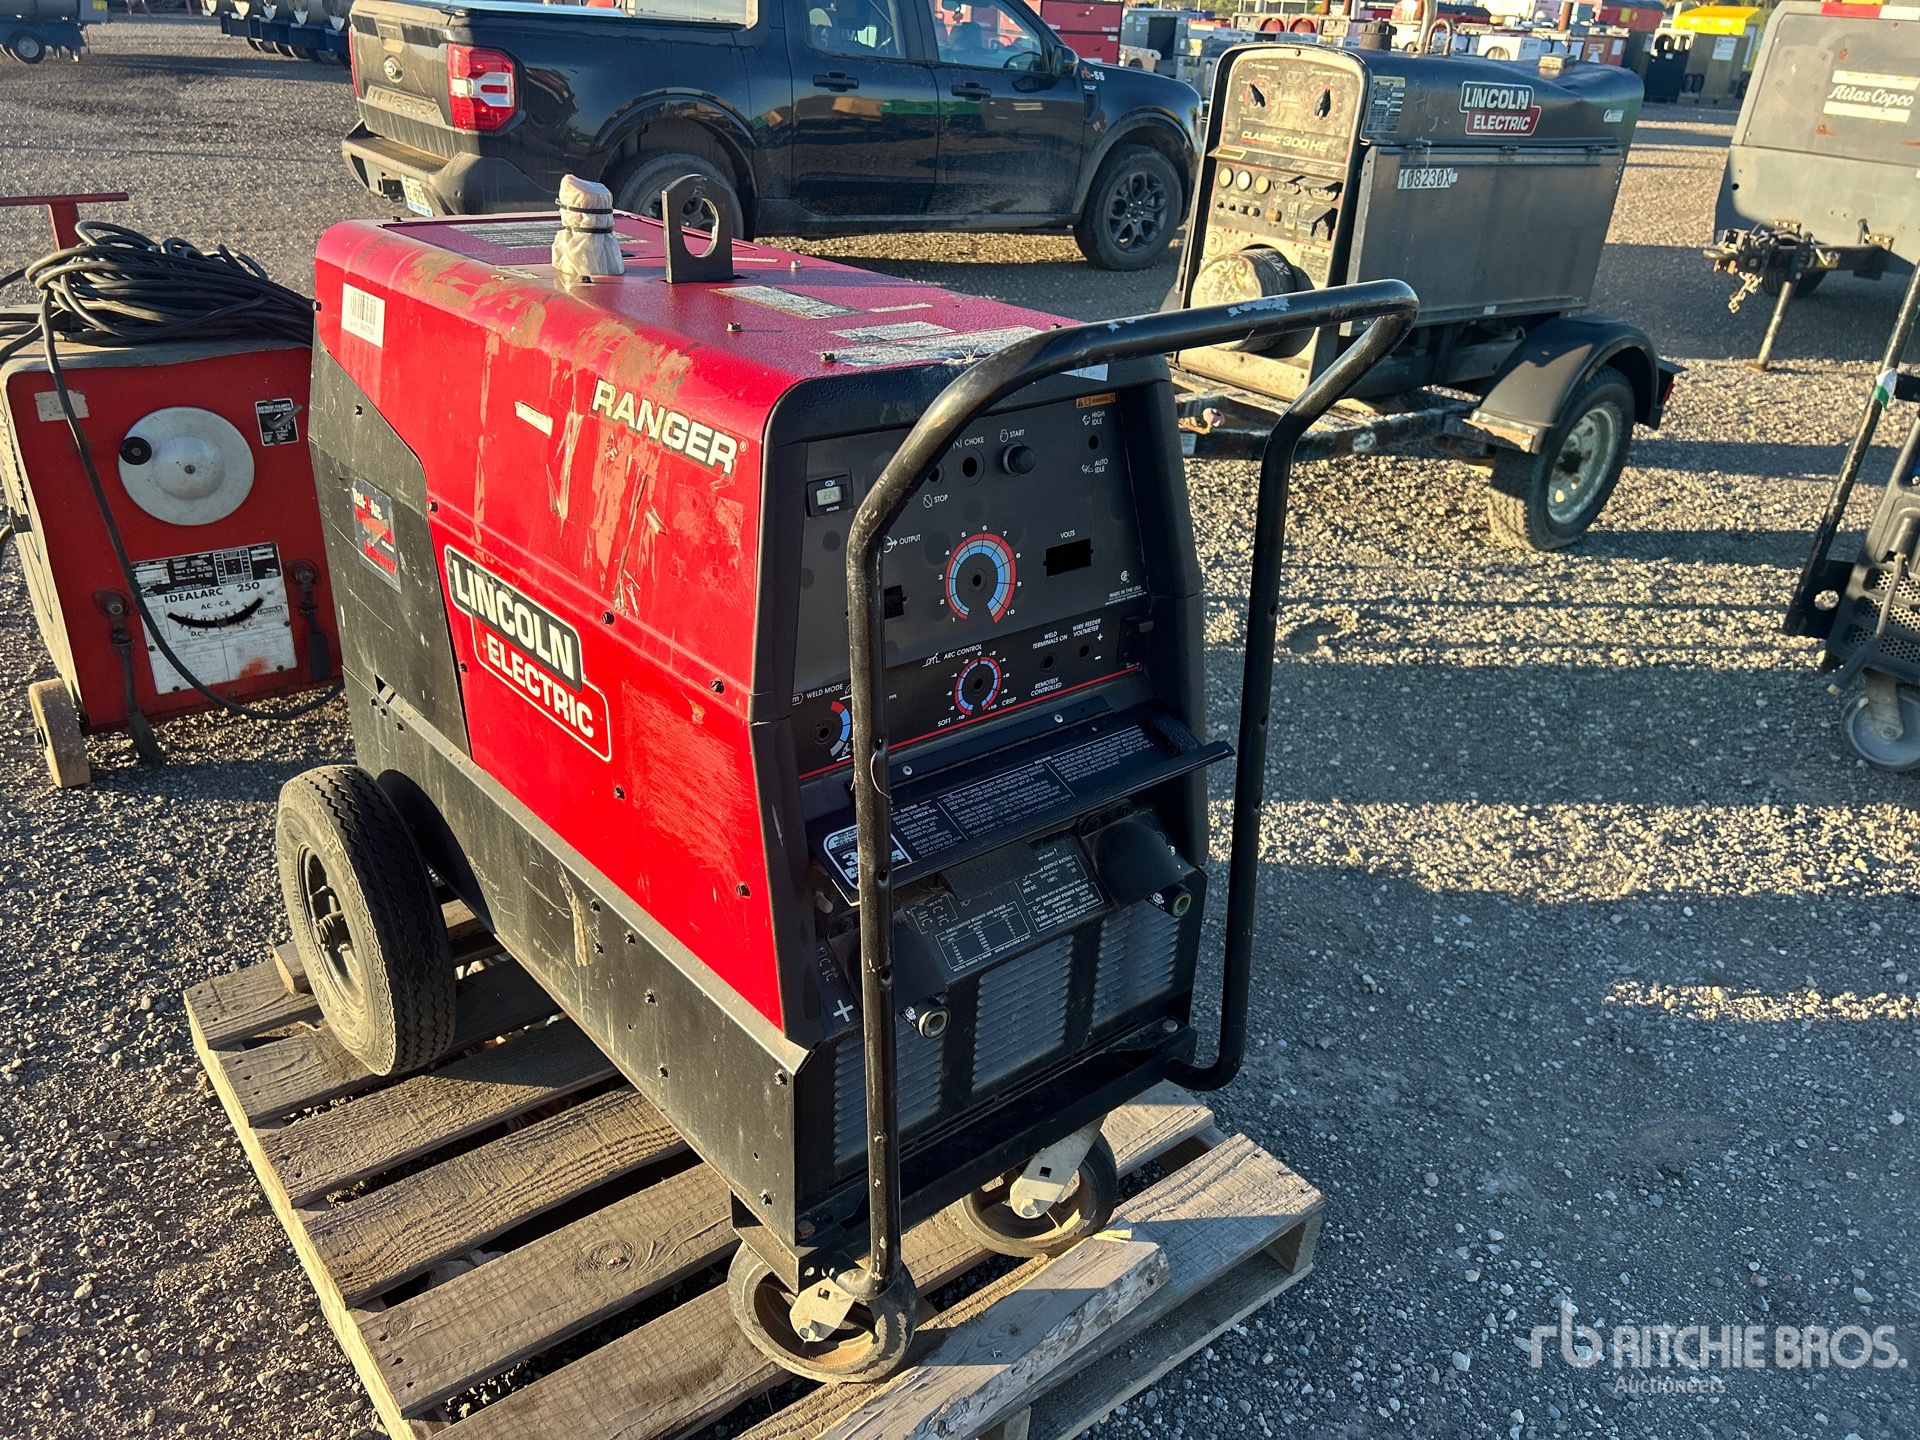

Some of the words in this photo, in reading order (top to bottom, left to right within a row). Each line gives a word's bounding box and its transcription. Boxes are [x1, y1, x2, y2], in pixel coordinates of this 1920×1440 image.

[1463, 87, 1531, 110] LINCOLN
[1827, 84, 1871, 103] Atlas
[1871, 88, 1915, 107] Copco
[1472, 114, 1531, 131] ELECTRIC
[1241, 130, 1281, 144] CLASSIC
[1281, 136, 1309, 149] 300
[1309, 140, 1329, 151] HE
[1091, 410, 1105, 418] HIGH
[591, 379, 738, 474] RANGER
[1091, 417, 1103, 426] IDLE
[1009, 428, 1025, 439] START
[964, 435, 985, 447] CHOKE
[1094, 457, 1109, 467] AUTO
[1094, 465, 1106, 474] IDLE
[933, 494, 949, 503] STOP
[899, 533, 922, 546] OUTPUT
[1060, 529, 1076, 539] VOLTS
[164, 587, 224, 604] IDEALARC
[237, 581, 261, 593] 250
[1109, 589, 1120, 598] MADE
[451, 560, 576, 681] LINCOLN
[1072, 623, 1084, 632] WIRE
[1084, 618, 1102, 628] FEEDER
[1044, 630, 1058, 640] WELD
[1073, 624, 1100, 638] VOLTMETER
[1032, 636, 1059, 650] TERMINALS
[1059, 634, 1068, 642] ON
[943, 651, 956, 660] ARC
[956, 644, 983, 656] CONTROL
[485, 632, 595, 740] ELECTRIC
[1030, 682, 1062, 696] CONTROLLED
[1034, 676, 1060, 690] REMOTELY
[806, 689, 823, 699] WELD
[824, 683, 844, 694] MODE
[1001, 696, 1017, 706] CRISP
[937, 718, 952, 726] SOFT
